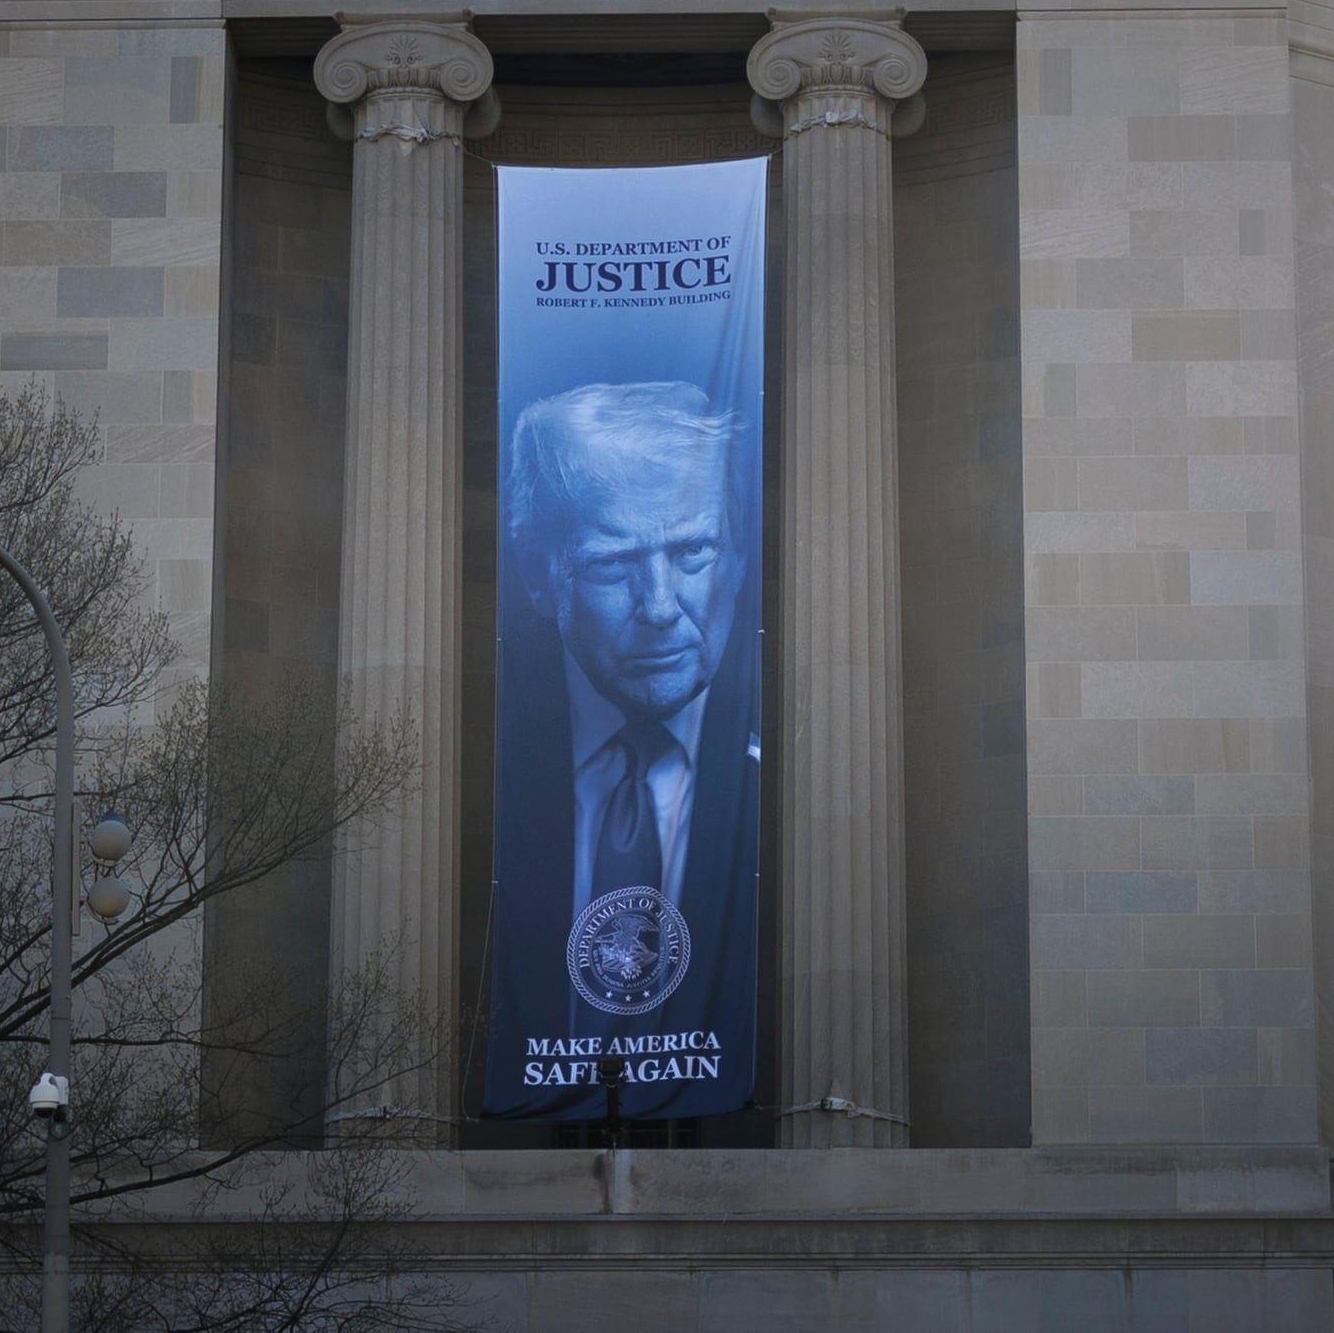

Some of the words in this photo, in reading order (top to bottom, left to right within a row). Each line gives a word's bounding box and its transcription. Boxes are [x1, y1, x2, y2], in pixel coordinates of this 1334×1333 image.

[536, 242, 570, 256] U.S.
[575, 239, 703, 256] DEPARTMENT
[707, 235, 731, 250] OF
[535, 254, 732, 293] JUSTICE
[536, 296, 588, 308] ROBERT
[590, 298, 601, 308] F.
[604, 297, 666, 308] KENNEDY
[668, 290, 731, 306] BUILDING
[578, 898, 636, 969] DEPARTMENT
[638, 897, 657, 911] OF
[526, 1037, 602, 1056] MAKE
[606, 1030, 722, 1055] AMERICA
